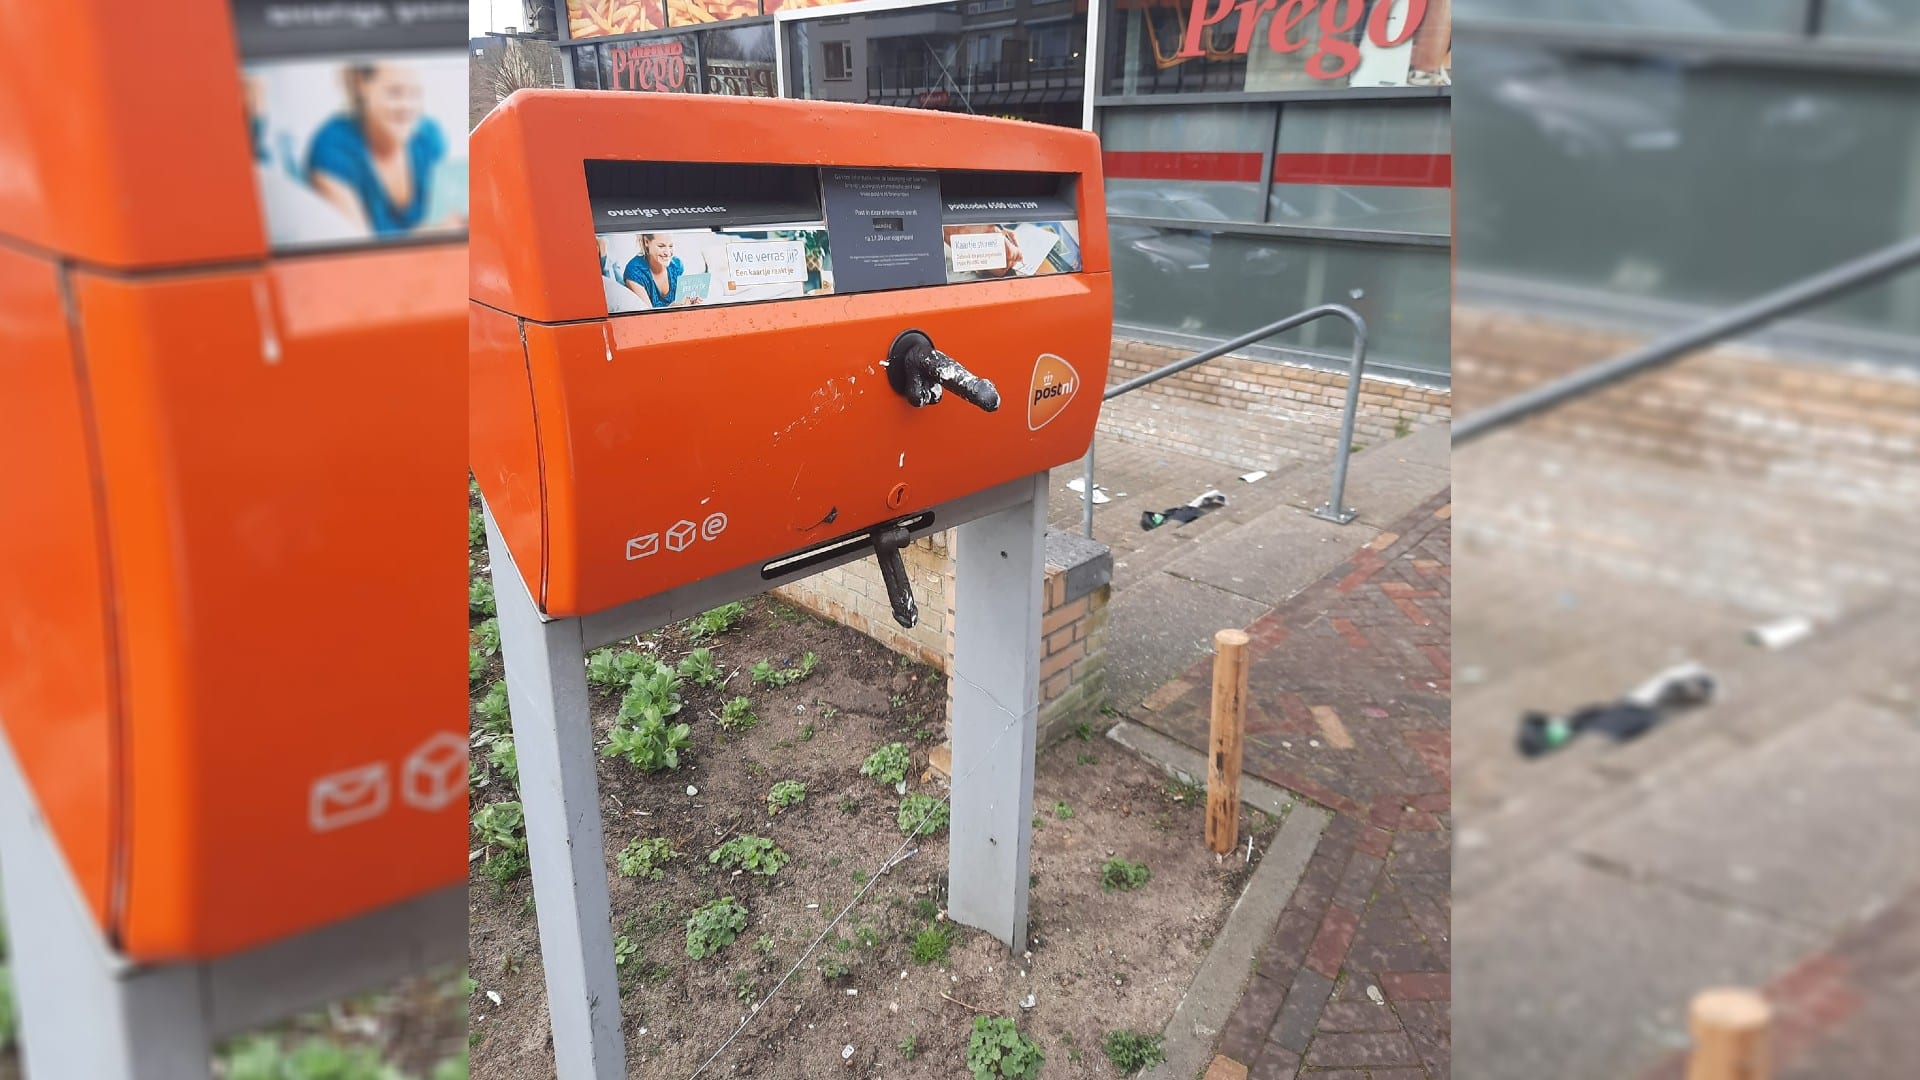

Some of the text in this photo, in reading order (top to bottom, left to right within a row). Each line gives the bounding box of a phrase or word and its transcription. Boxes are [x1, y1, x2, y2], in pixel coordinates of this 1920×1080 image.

[1178, 0, 1427, 79] Prego
[611, 48, 685, 92] Prego
[607, 205, 727, 218] overige postcodes
[948, 202, 988, 211] postcodes
[955, 240, 977, 250] Kaartje
[733, 251, 754, 263] Wie
[755, 252, 785, 262] verras
[735, 269, 748, 277] Een
[748, 267, 770, 277] kaartje
[1034, 377, 1074, 406] postnl
